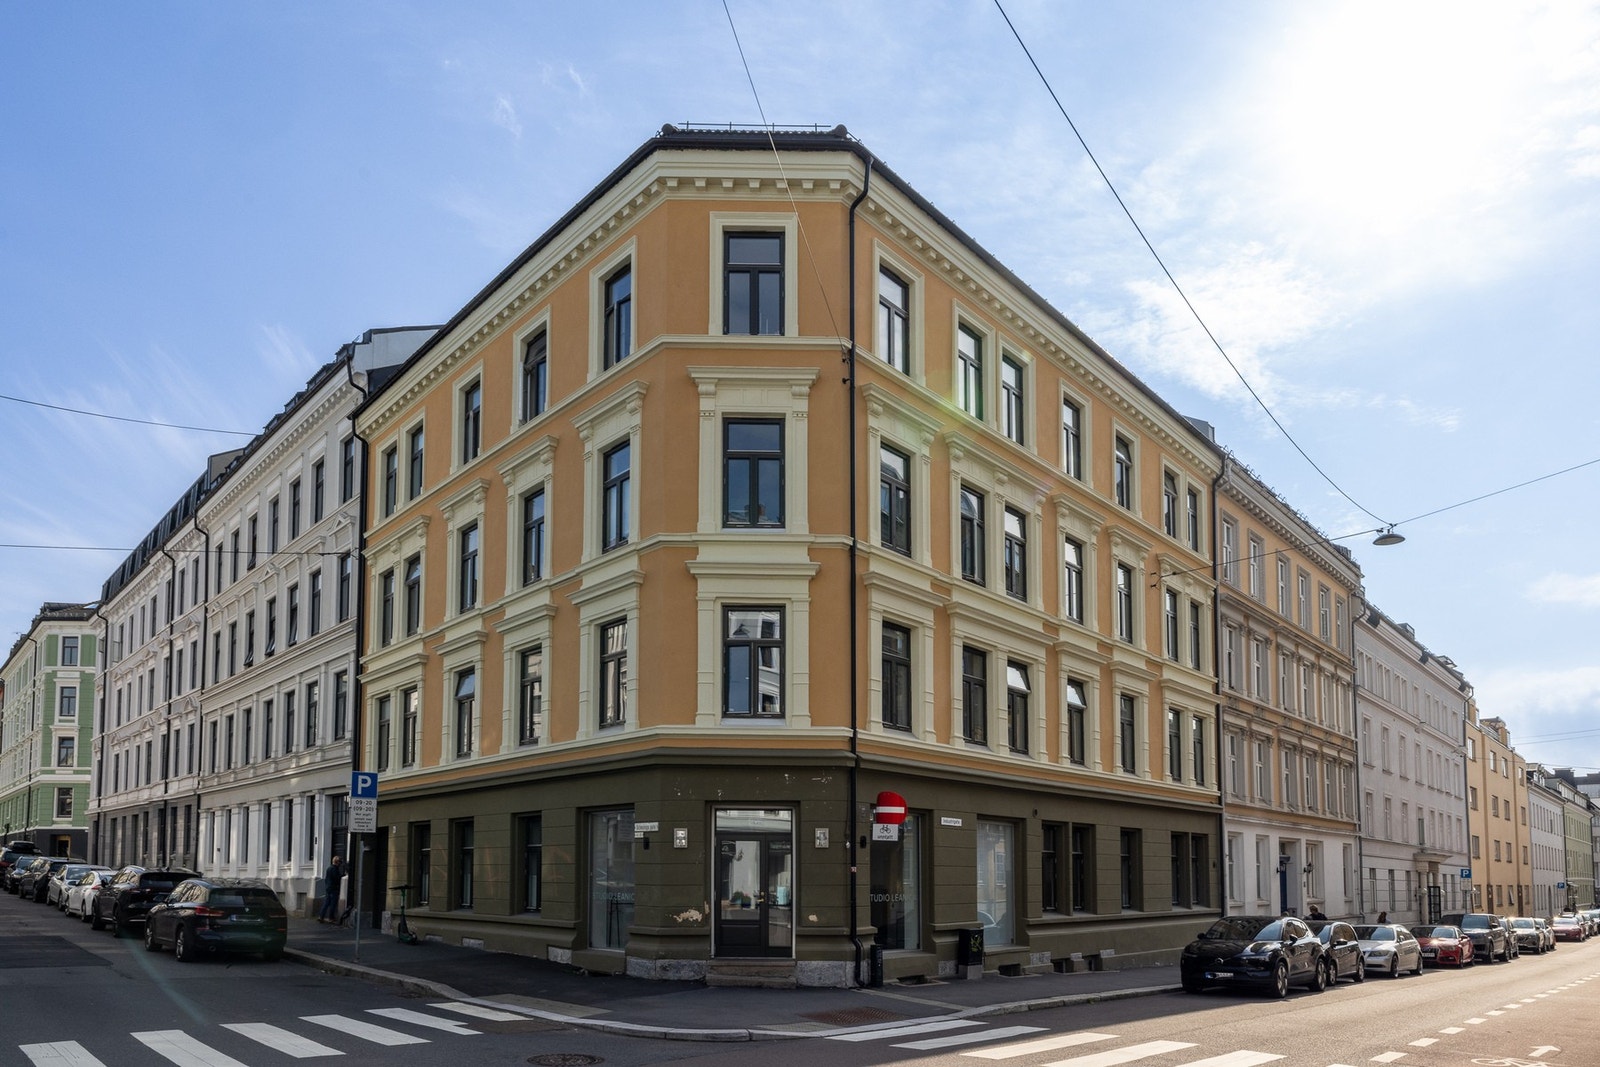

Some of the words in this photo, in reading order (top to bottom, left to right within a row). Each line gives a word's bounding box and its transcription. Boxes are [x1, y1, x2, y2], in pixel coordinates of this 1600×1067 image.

[357, 775, 371, 795] P
[1463, 869, 1469, 878] P
[870, 893, 890, 902] TUDIO
